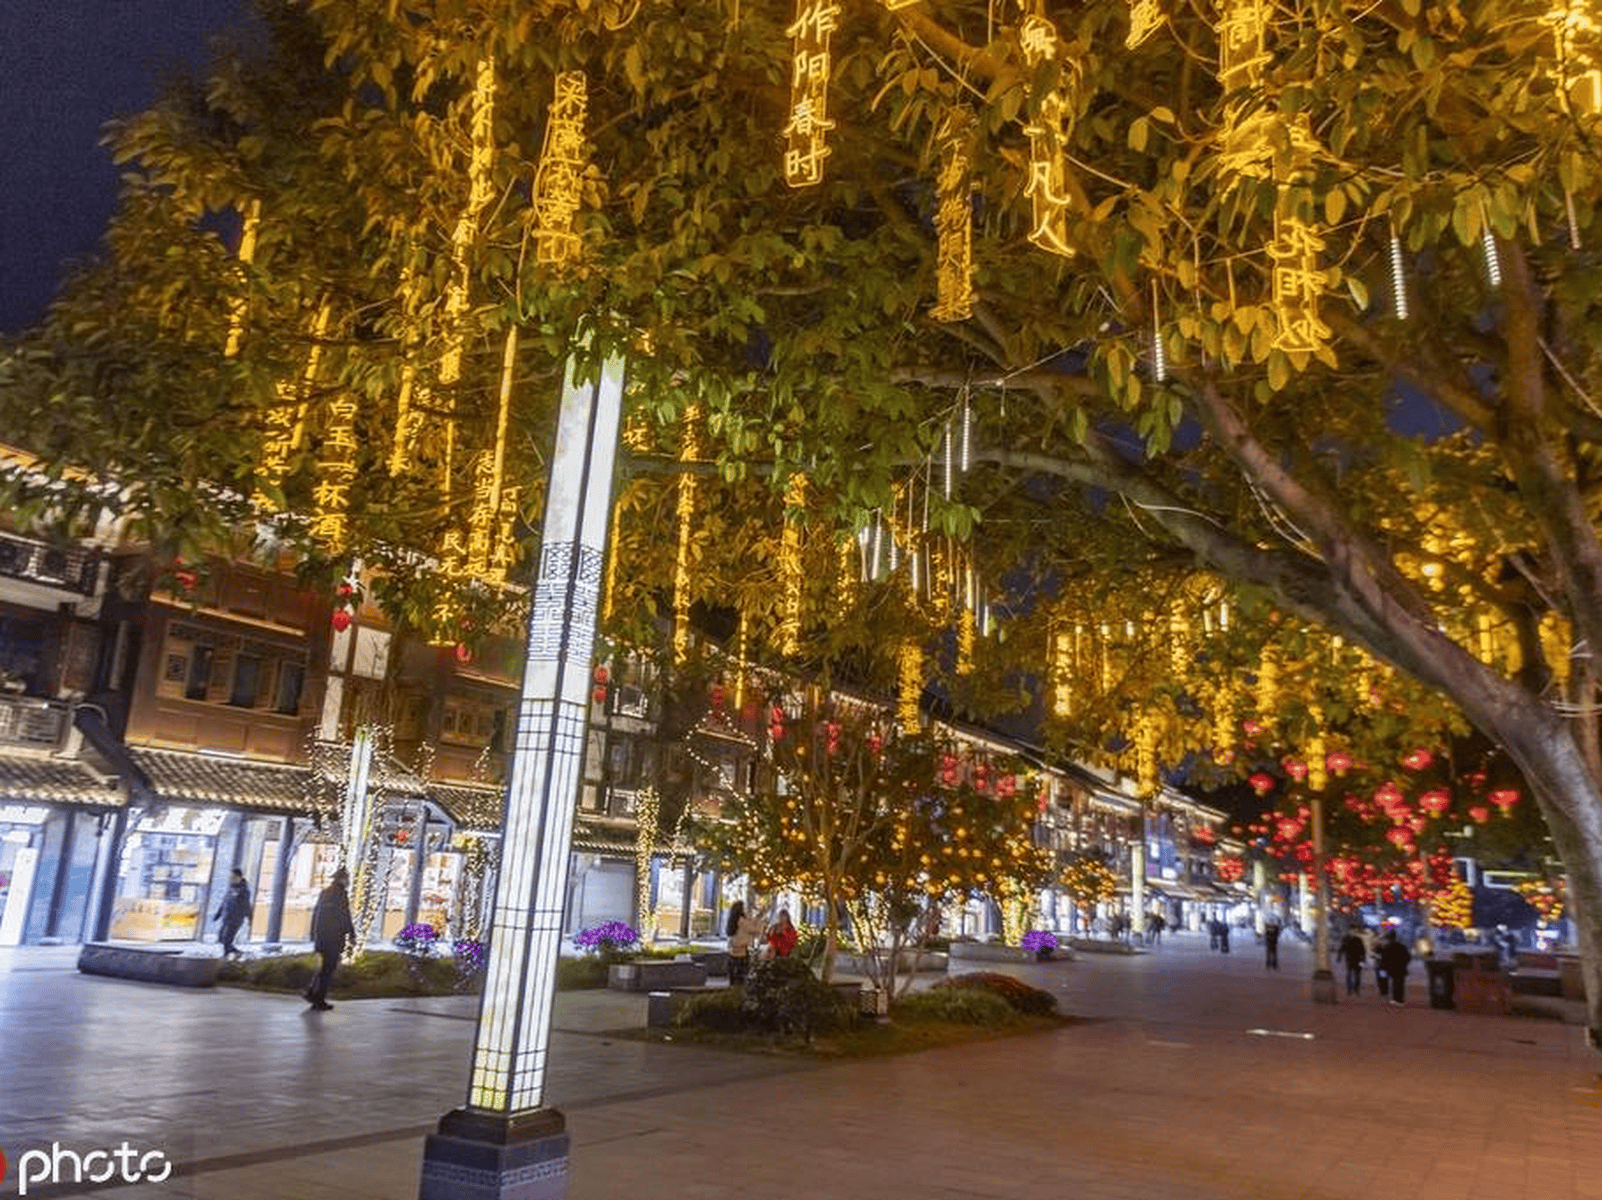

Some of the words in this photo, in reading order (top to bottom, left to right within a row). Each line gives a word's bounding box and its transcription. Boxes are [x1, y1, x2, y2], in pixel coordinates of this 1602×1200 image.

[782, 0, 840, 182] 作阳春时
[308, 399, 358, 542] 白玉一杯酒
